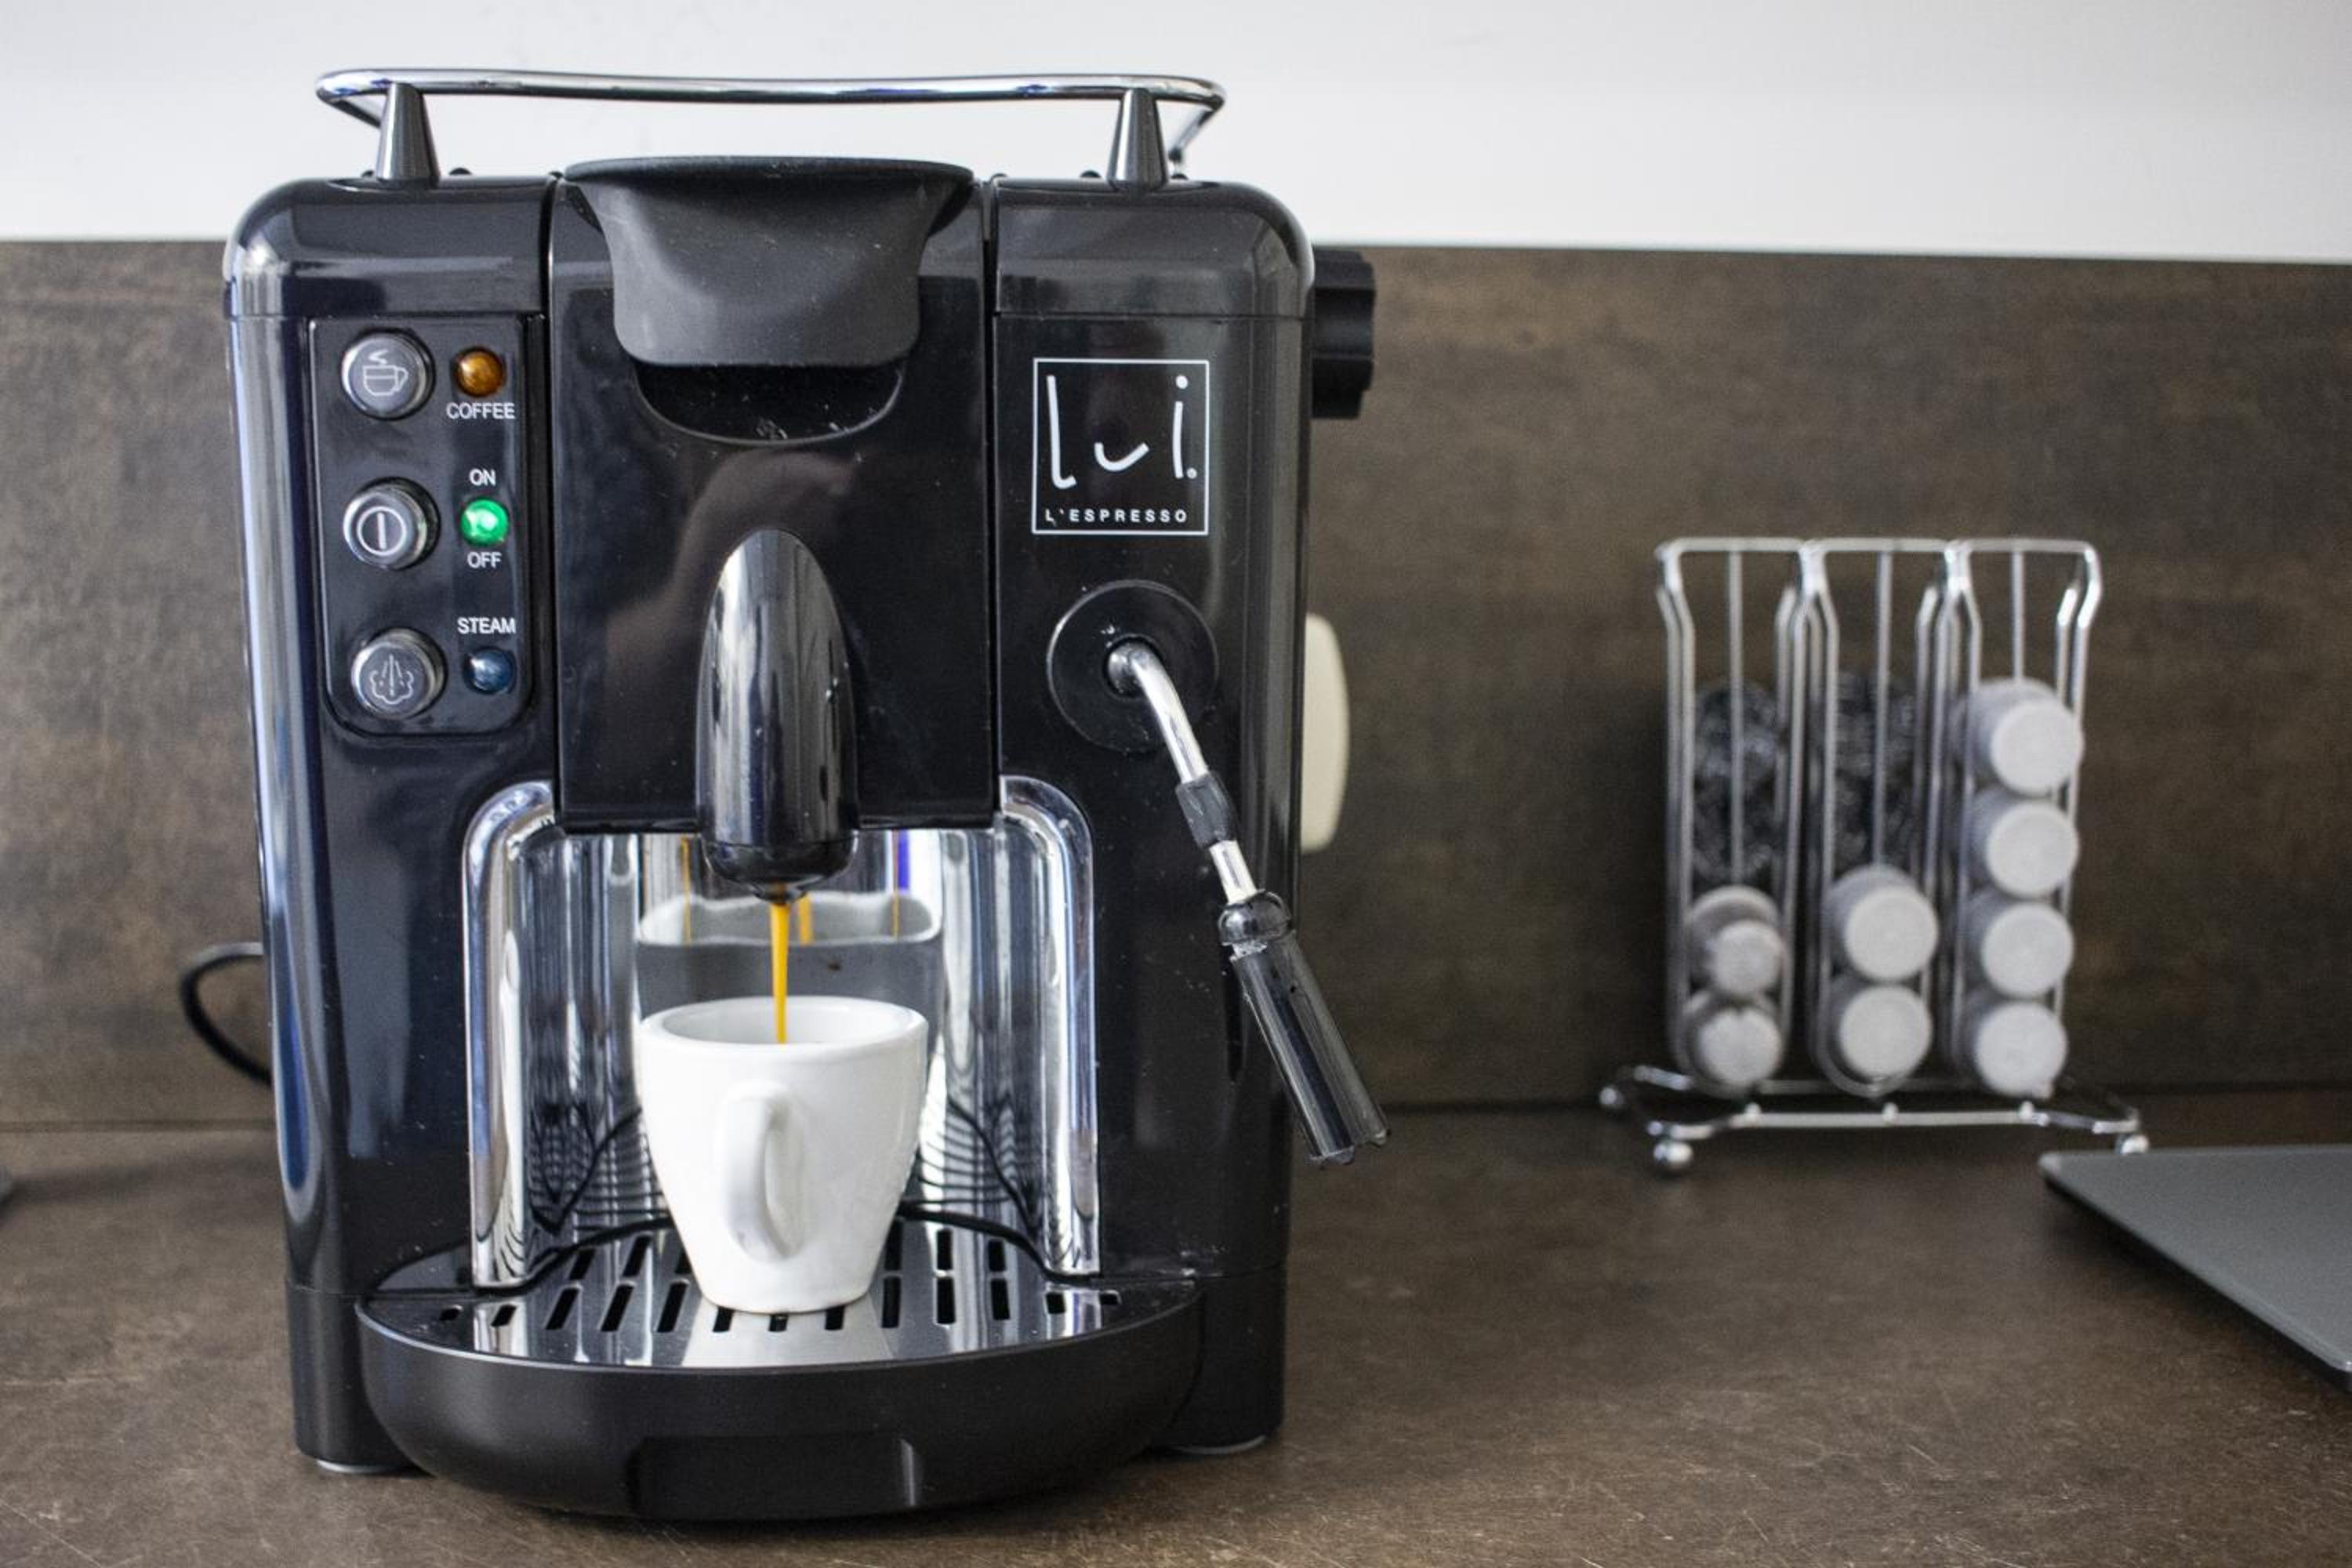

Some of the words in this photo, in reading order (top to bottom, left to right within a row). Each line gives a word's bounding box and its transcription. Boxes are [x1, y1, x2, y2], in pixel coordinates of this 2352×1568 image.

[446, 402, 516, 419] COFFEE
[469, 469, 496, 486] ON
[1045, 509, 1187, 526] L'ESPRESSO
[467, 551, 502, 569] OFF
[457, 617, 517, 634] STEAM
